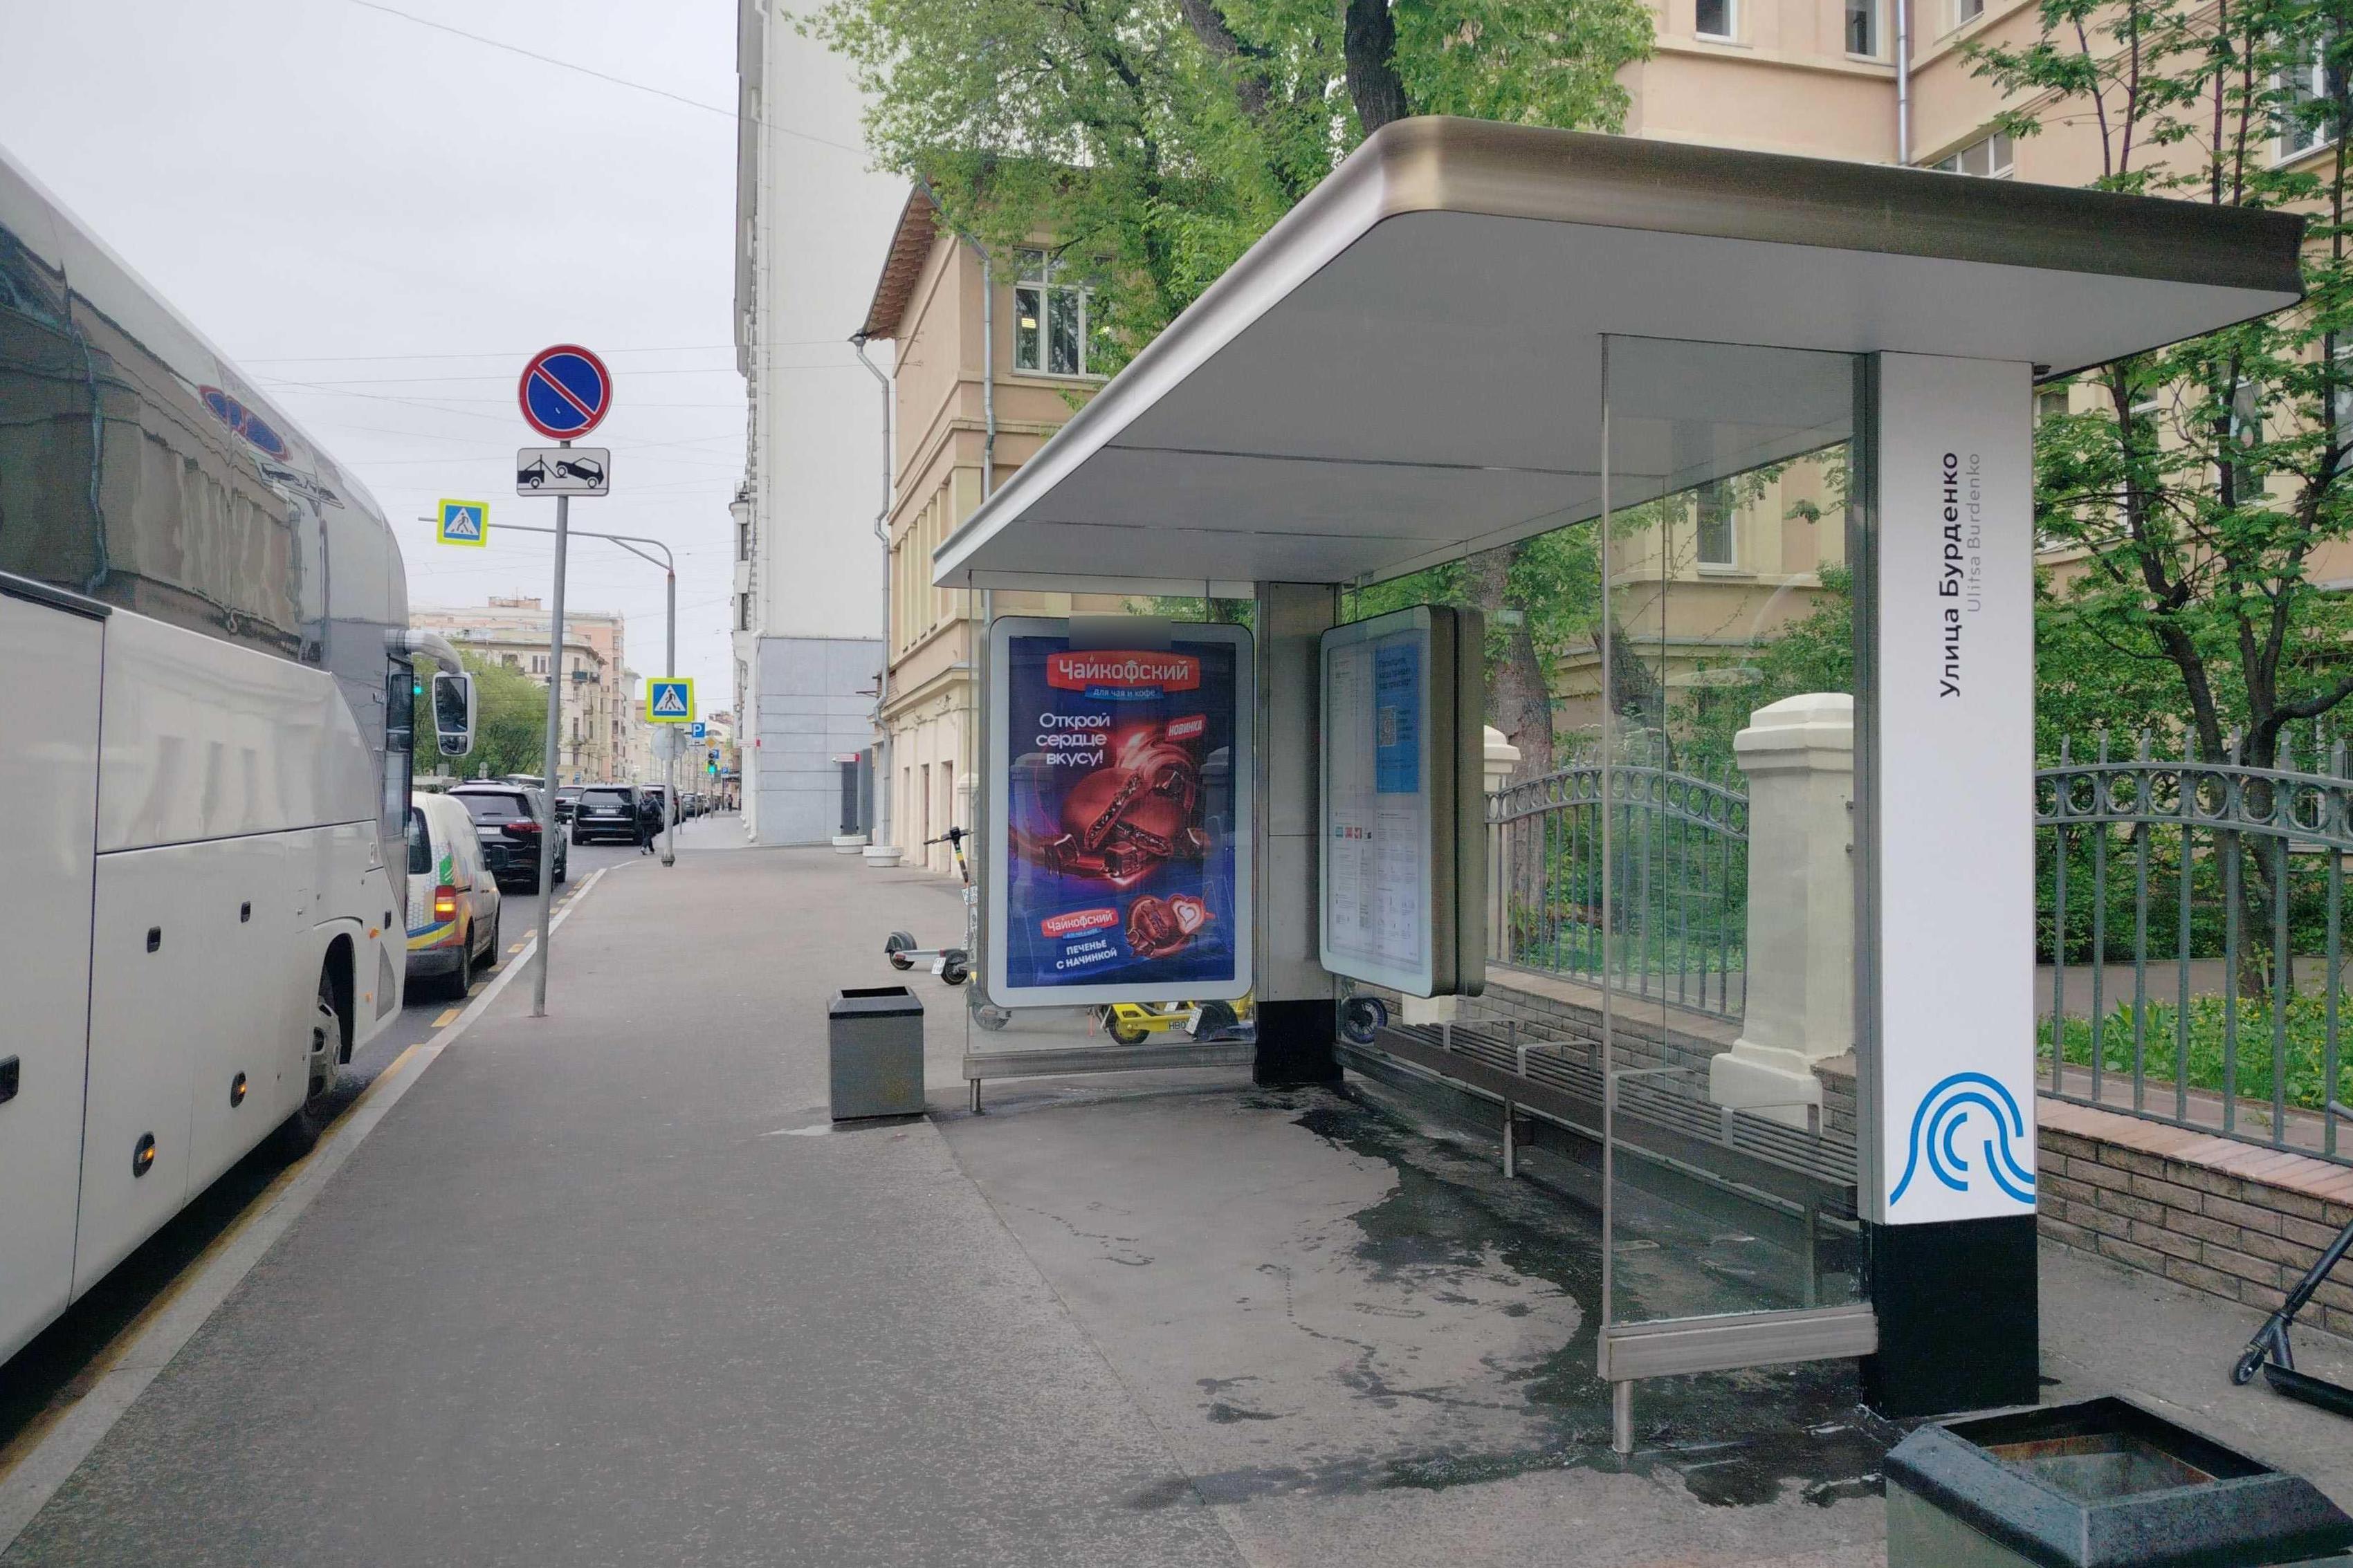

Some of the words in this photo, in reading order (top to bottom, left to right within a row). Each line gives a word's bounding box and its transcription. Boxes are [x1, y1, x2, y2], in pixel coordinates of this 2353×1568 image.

[1966, 453, 1981, 549] Burdenko
[1939, 452, 1963, 597] Бурденко
[1967, 556, 1981, 612] Ulitsa
[1940, 609, 1962, 698] Улица
[1059, 657, 1189, 683] Чайкофский
[1093, 688, 1108, 697] для
[1135, 689, 1155, 698] кофе
[1039, 712, 1110, 730] Открой
[1169, 720, 1202, 737] НОВИНКА
[1036, 733, 1107, 748] сердце
[1046, 750, 1104, 767] вкусу!
[1047, 910, 1113, 932] Чайкофский
[1056, 961, 1065, 969] С
[1065, 947, 1117, 968] НАЧИНКОЙ
[1066, 939, 1107, 955] ПЕЧЕНЬЕ
